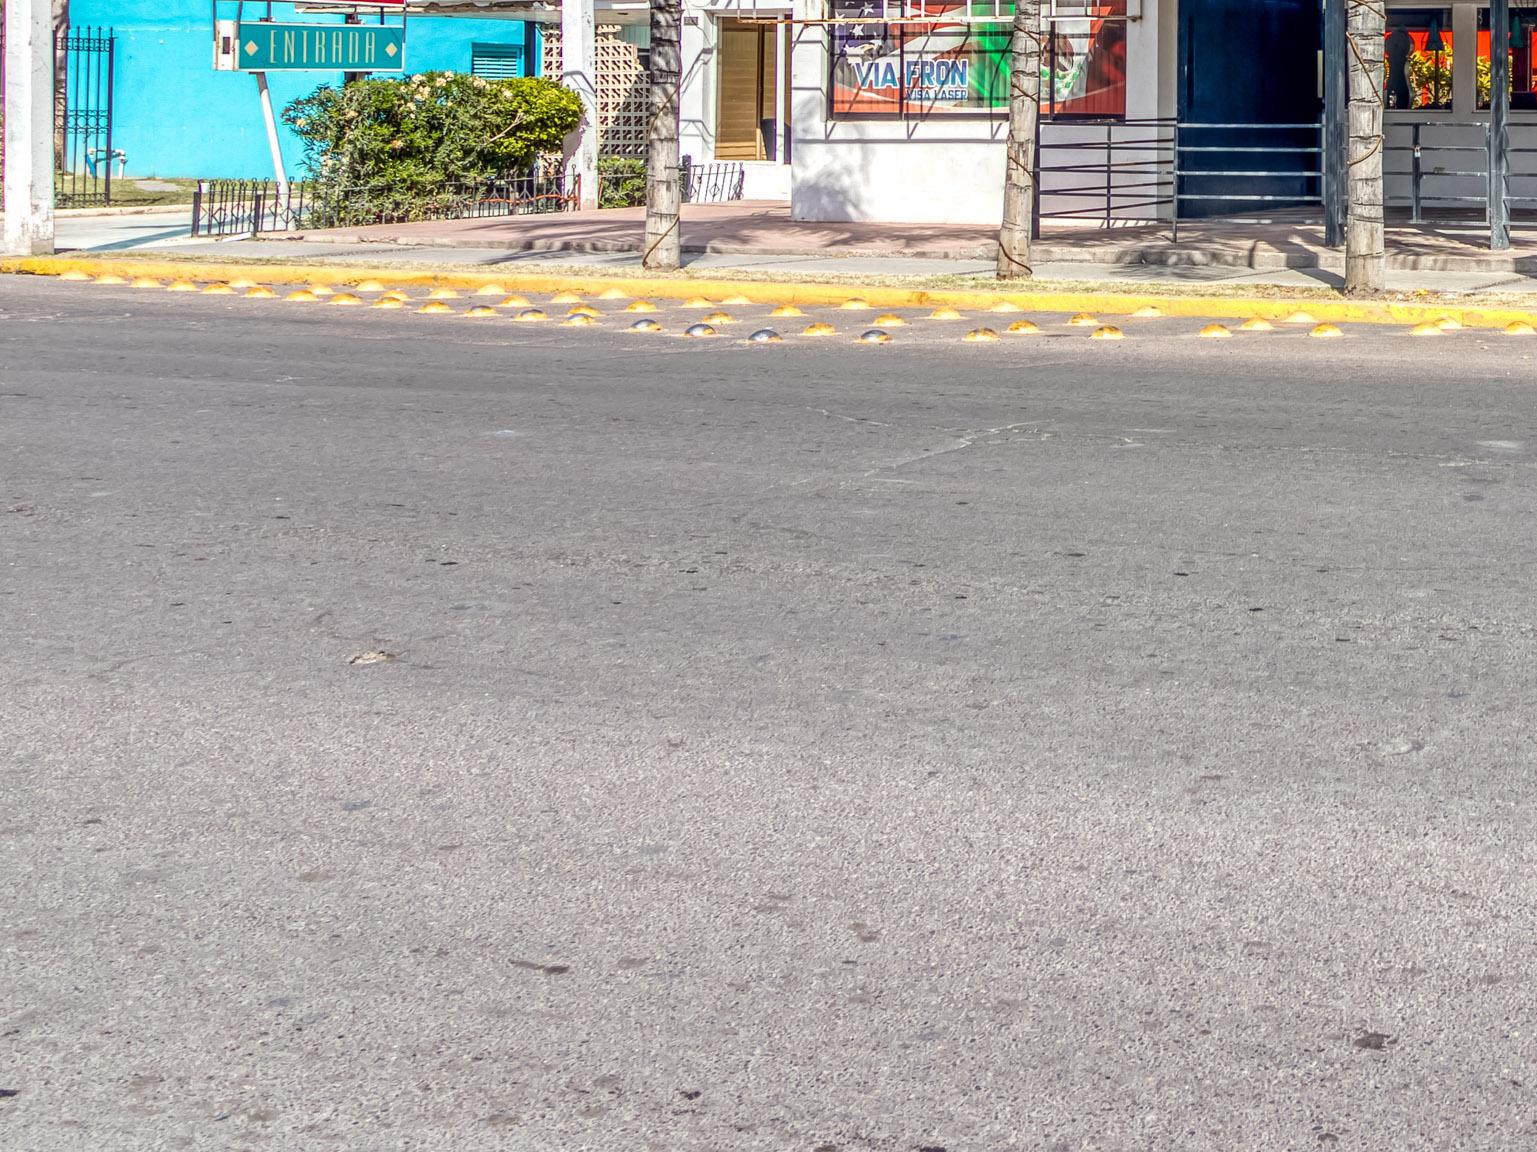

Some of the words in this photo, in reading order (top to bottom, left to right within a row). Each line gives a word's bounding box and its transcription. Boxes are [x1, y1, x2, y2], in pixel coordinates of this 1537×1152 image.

[270, 29, 376, 64] ENTRADA
[855, 61, 899, 88] VIA
[905, 59, 968, 88] FRON
[906, 90, 931, 100] VISA
